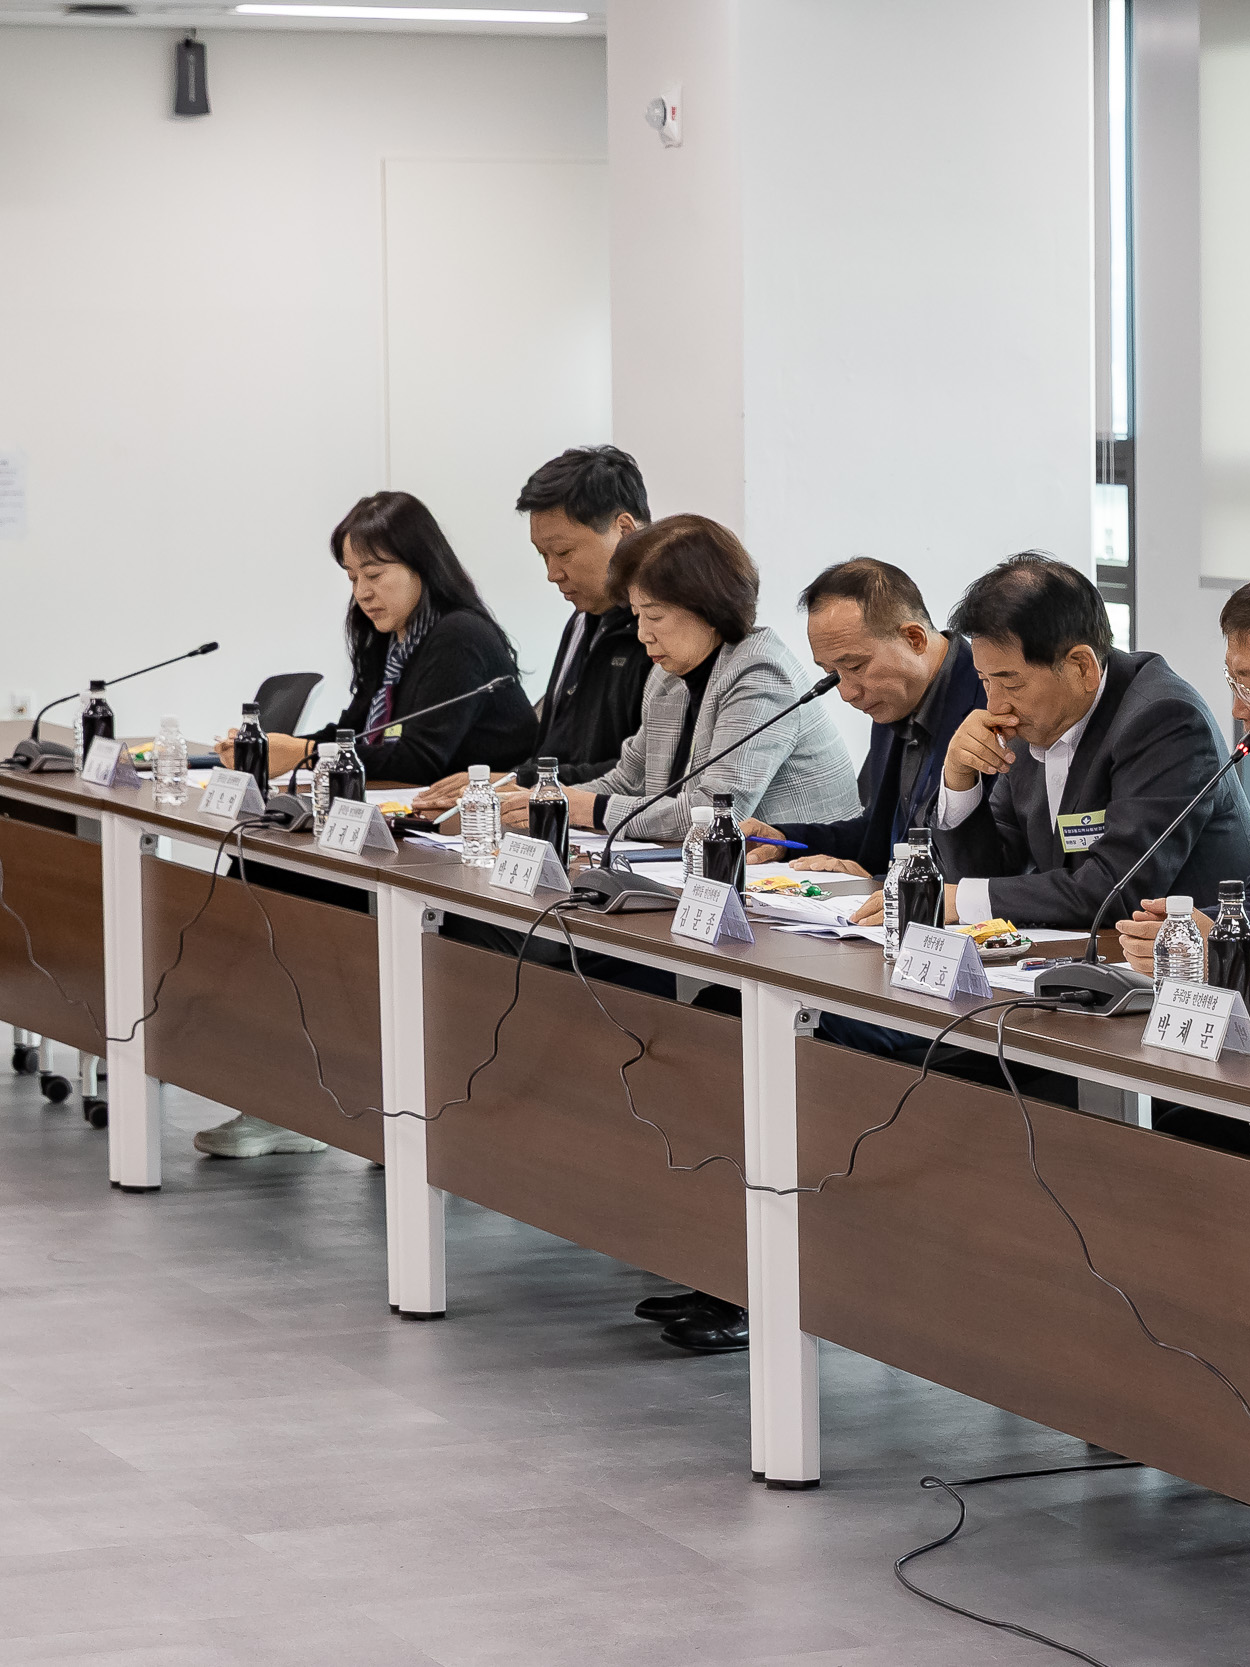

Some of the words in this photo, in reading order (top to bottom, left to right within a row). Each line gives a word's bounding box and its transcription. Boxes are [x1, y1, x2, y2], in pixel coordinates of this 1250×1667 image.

[680, 905, 716, 935] 김문종
[901, 956, 949, 987] 김경호
[1192, 992, 1219, 1011] 민간위원장
